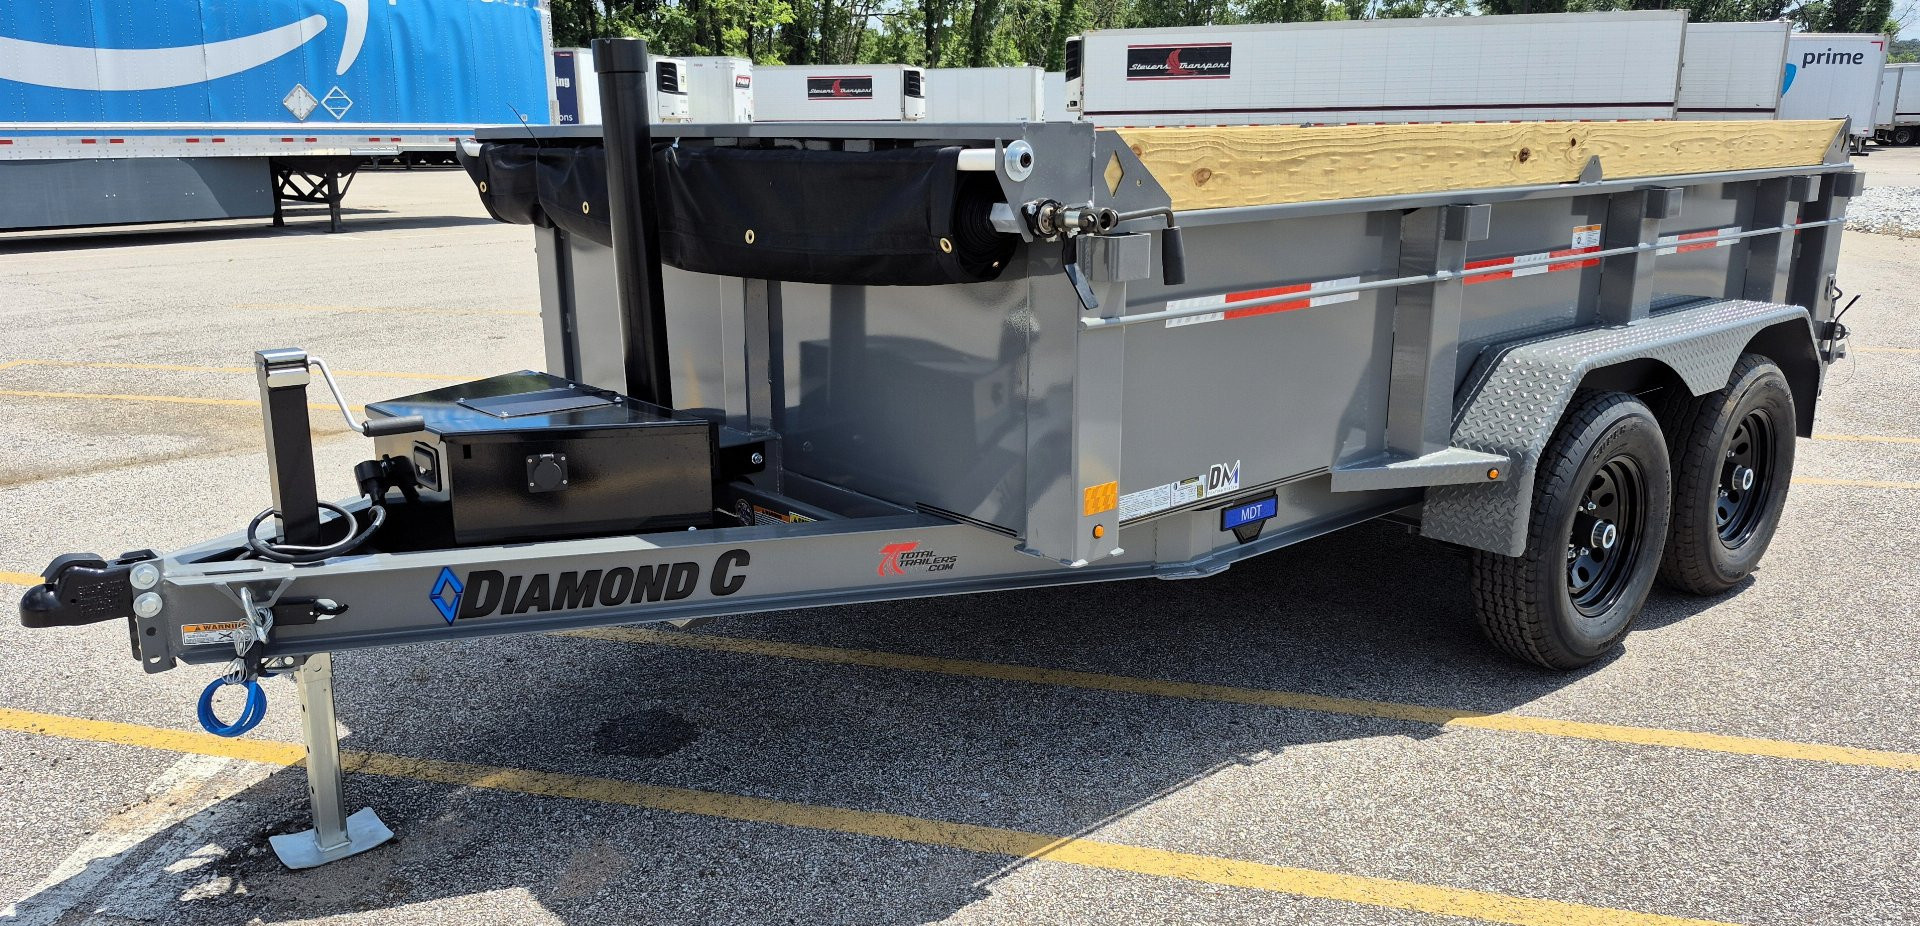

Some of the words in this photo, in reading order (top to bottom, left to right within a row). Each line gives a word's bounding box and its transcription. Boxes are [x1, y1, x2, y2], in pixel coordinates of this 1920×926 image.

[1802, 47, 1864, 69] prime
[1178, 61, 1230, 70] Transport
[1241, 504, 1263, 521] MDT
[899, 555, 958, 567] TRAILERS
[900, 550, 936, 560] TOTAL
[925, 563, 955, 572] .COM
[458, 561, 700, 619] DIAMOND
[709, 549, 751, 596] C
